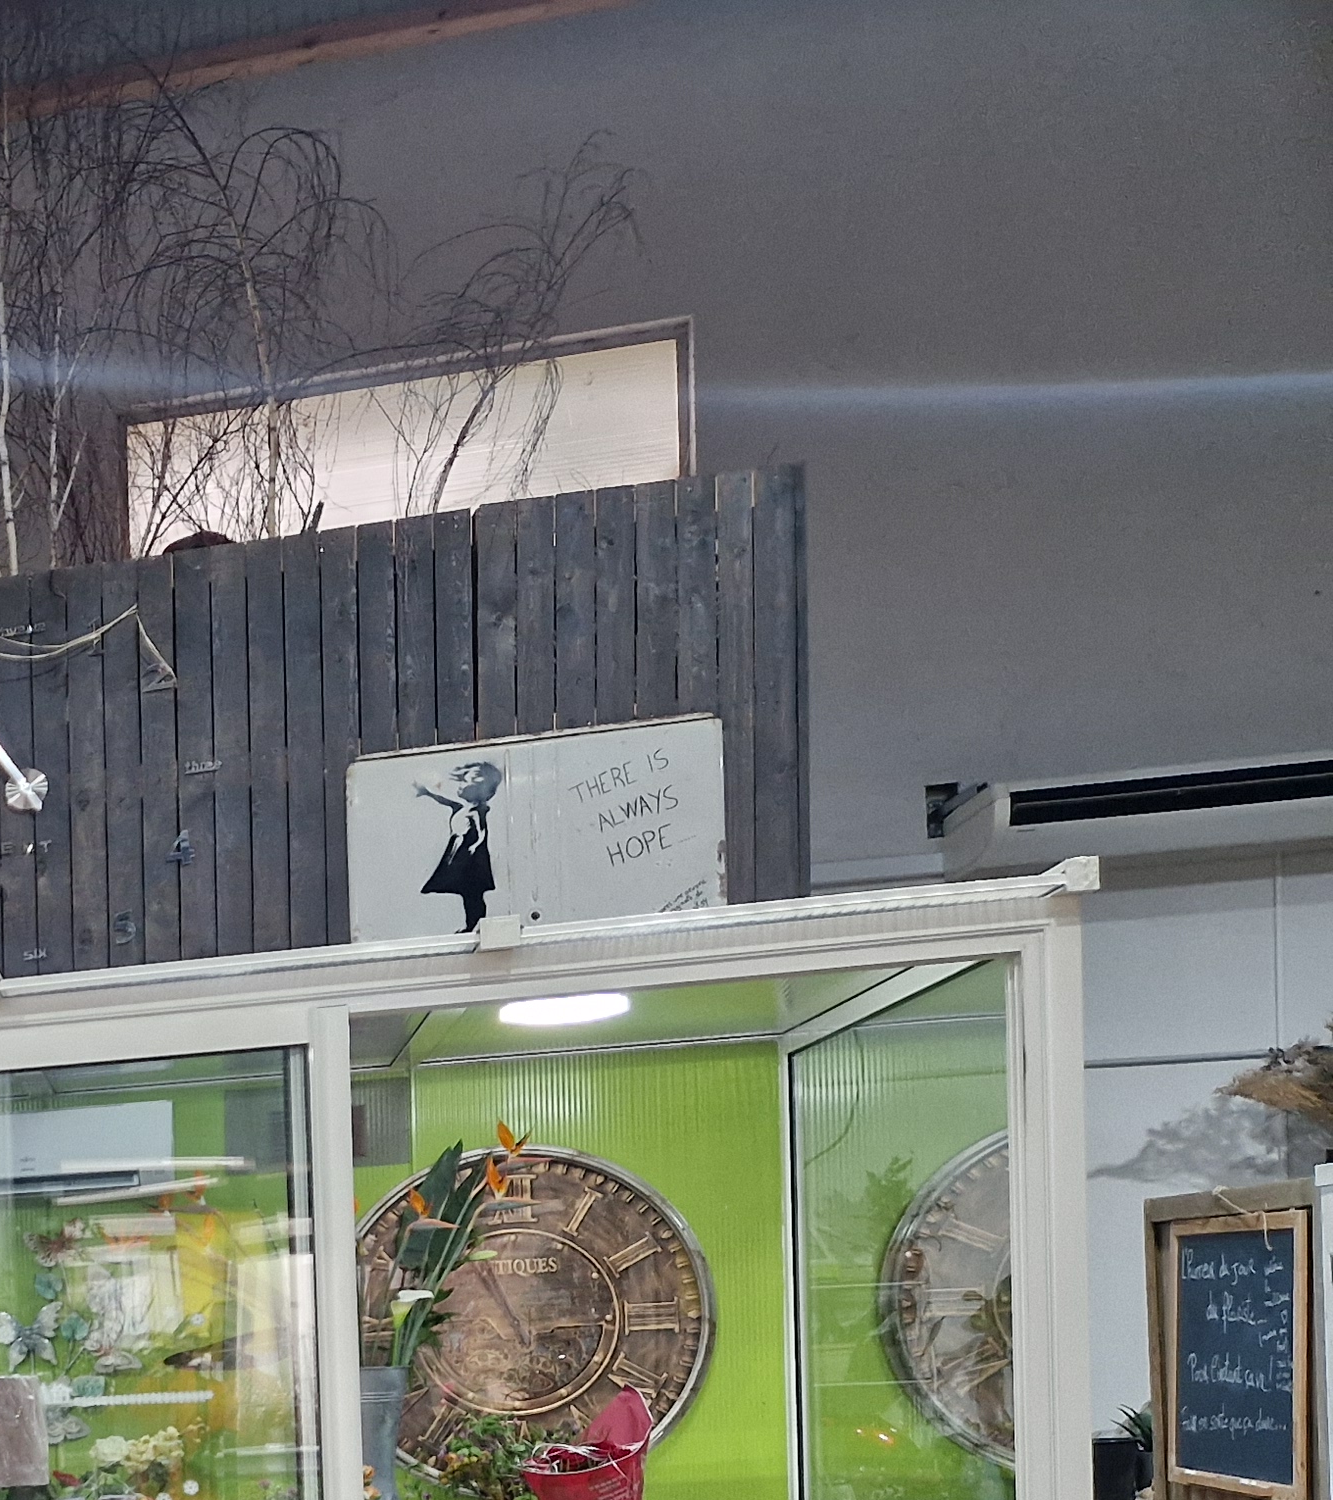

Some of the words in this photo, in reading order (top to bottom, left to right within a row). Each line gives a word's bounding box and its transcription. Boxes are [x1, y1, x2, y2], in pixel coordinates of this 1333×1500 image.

[569, 760, 637, 804] THERE
[646, 748, 671, 773] IS
[596, 783, 680, 833] ALWAYS
[165, 828, 196, 867] 4
[112, 908, 137, 945] 5
